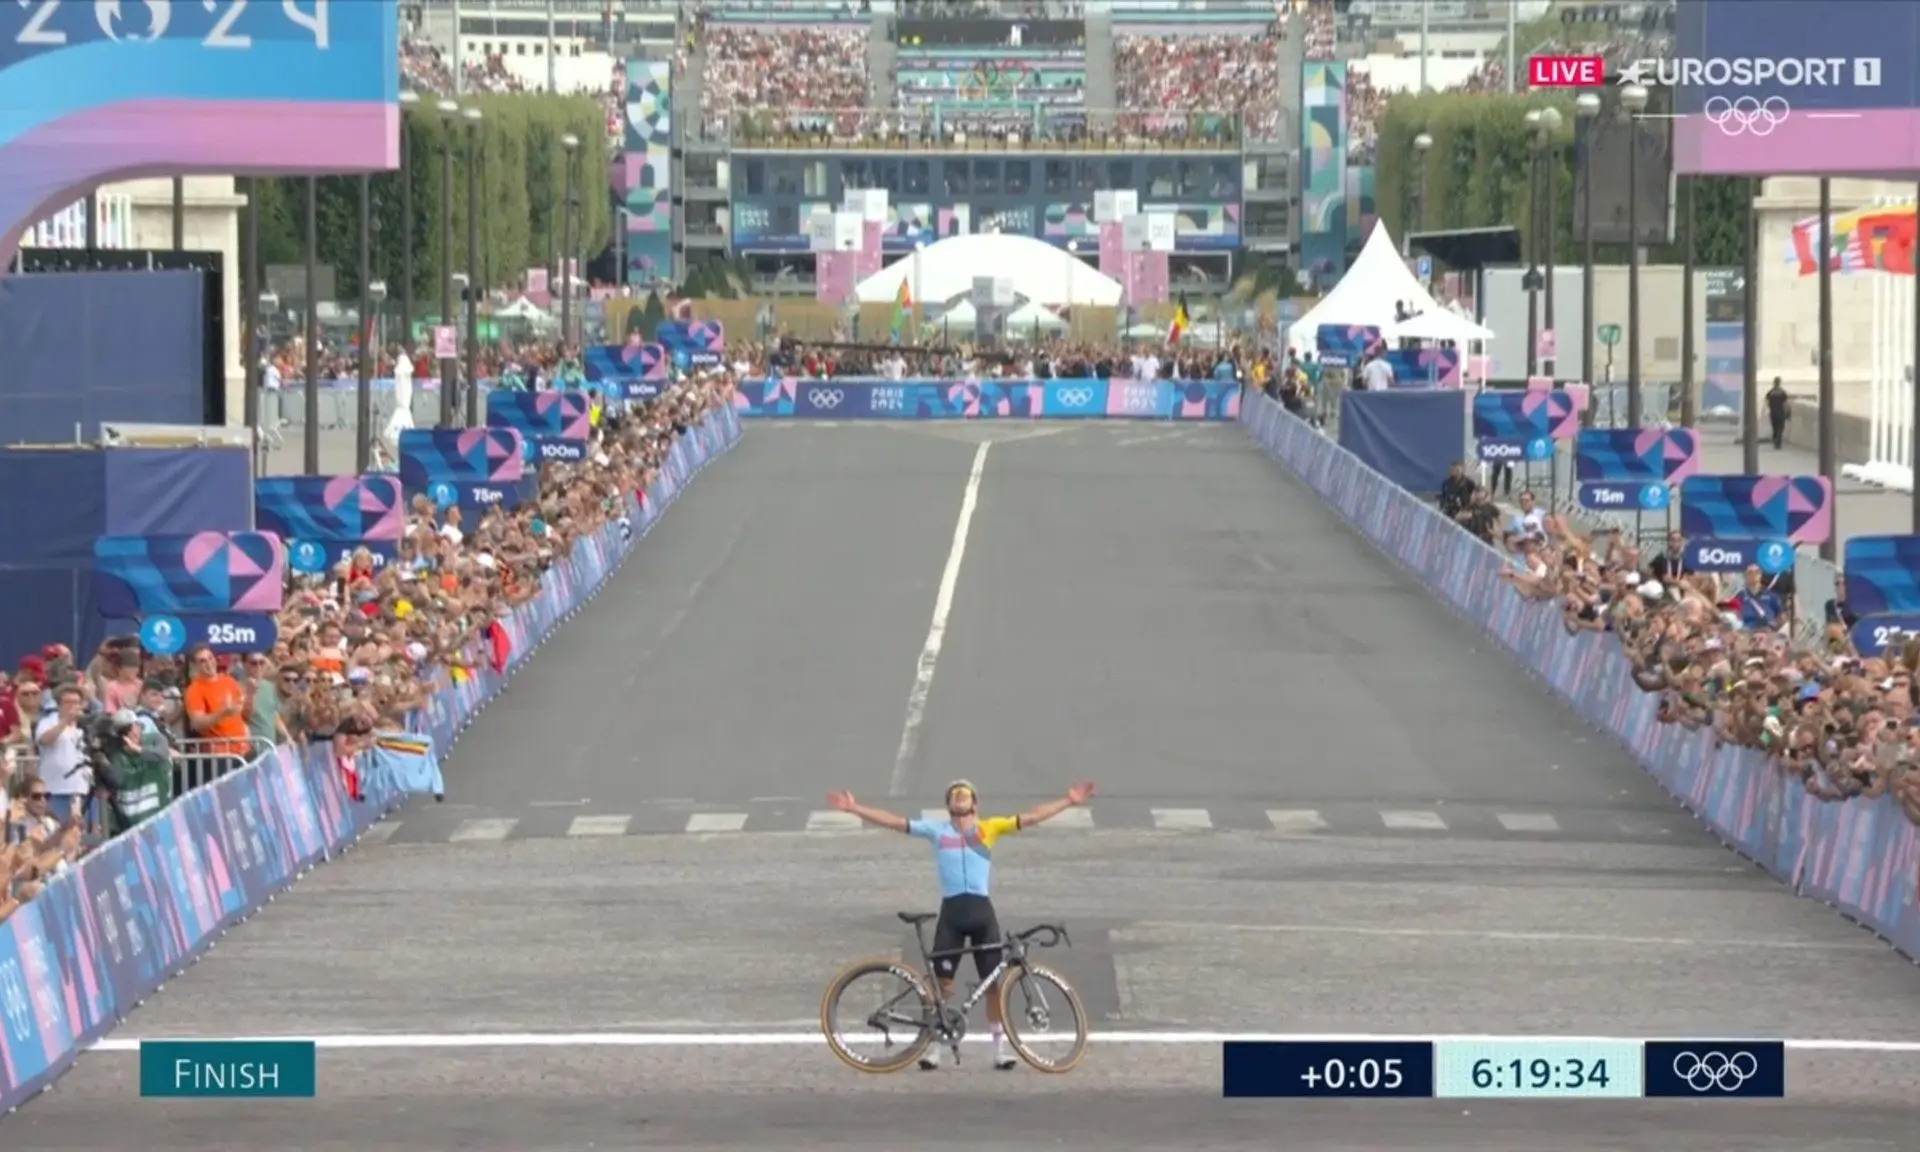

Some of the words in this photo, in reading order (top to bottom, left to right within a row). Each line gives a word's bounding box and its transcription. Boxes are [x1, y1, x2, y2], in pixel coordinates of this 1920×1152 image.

[871, 388, 904, 397] PARIS
[871, 399, 904, 410] 2024
[541, 444, 580, 457] 100m
[1482, 444, 1522, 457] 100m
[472, 487, 503, 502] 75m
[1592, 488, 1624, 503] 75m
[341, 549, 384, 566] 5m
[1698, 548, 1742, 565] 50m
[207, 623, 257, 644] 25m
